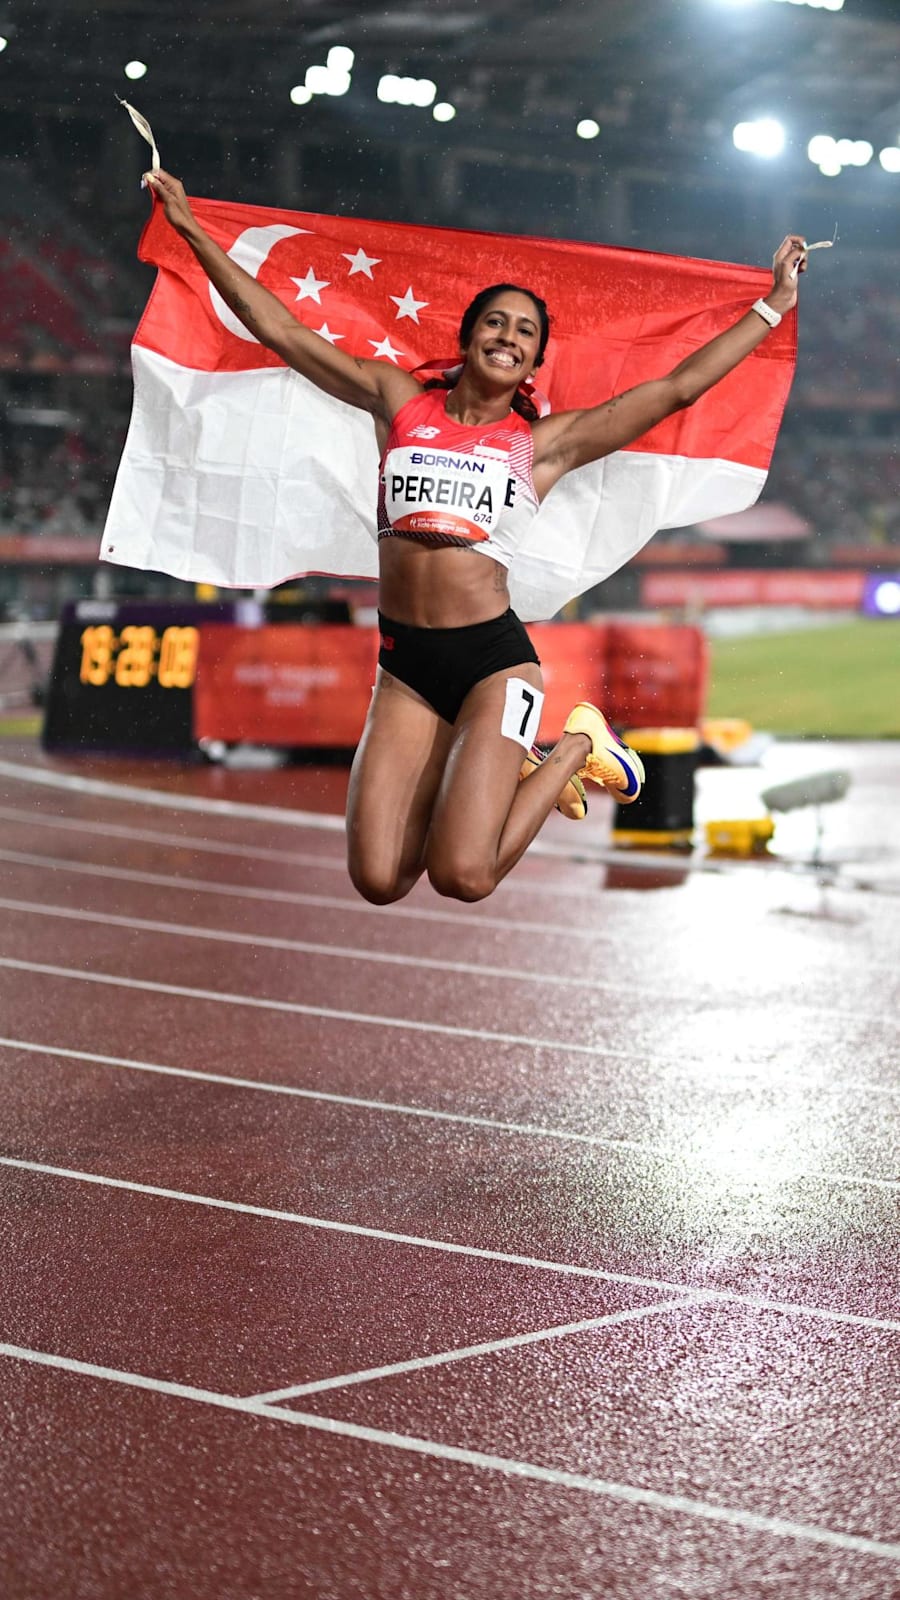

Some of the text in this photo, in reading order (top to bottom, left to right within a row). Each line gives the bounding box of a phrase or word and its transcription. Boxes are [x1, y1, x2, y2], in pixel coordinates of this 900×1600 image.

[410, 453, 485, 473] BORNAN
[391, 475, 493, 513] PEREIRA
[473, 513, 492, 525] 674
[519, 688, 534, 737] 7
